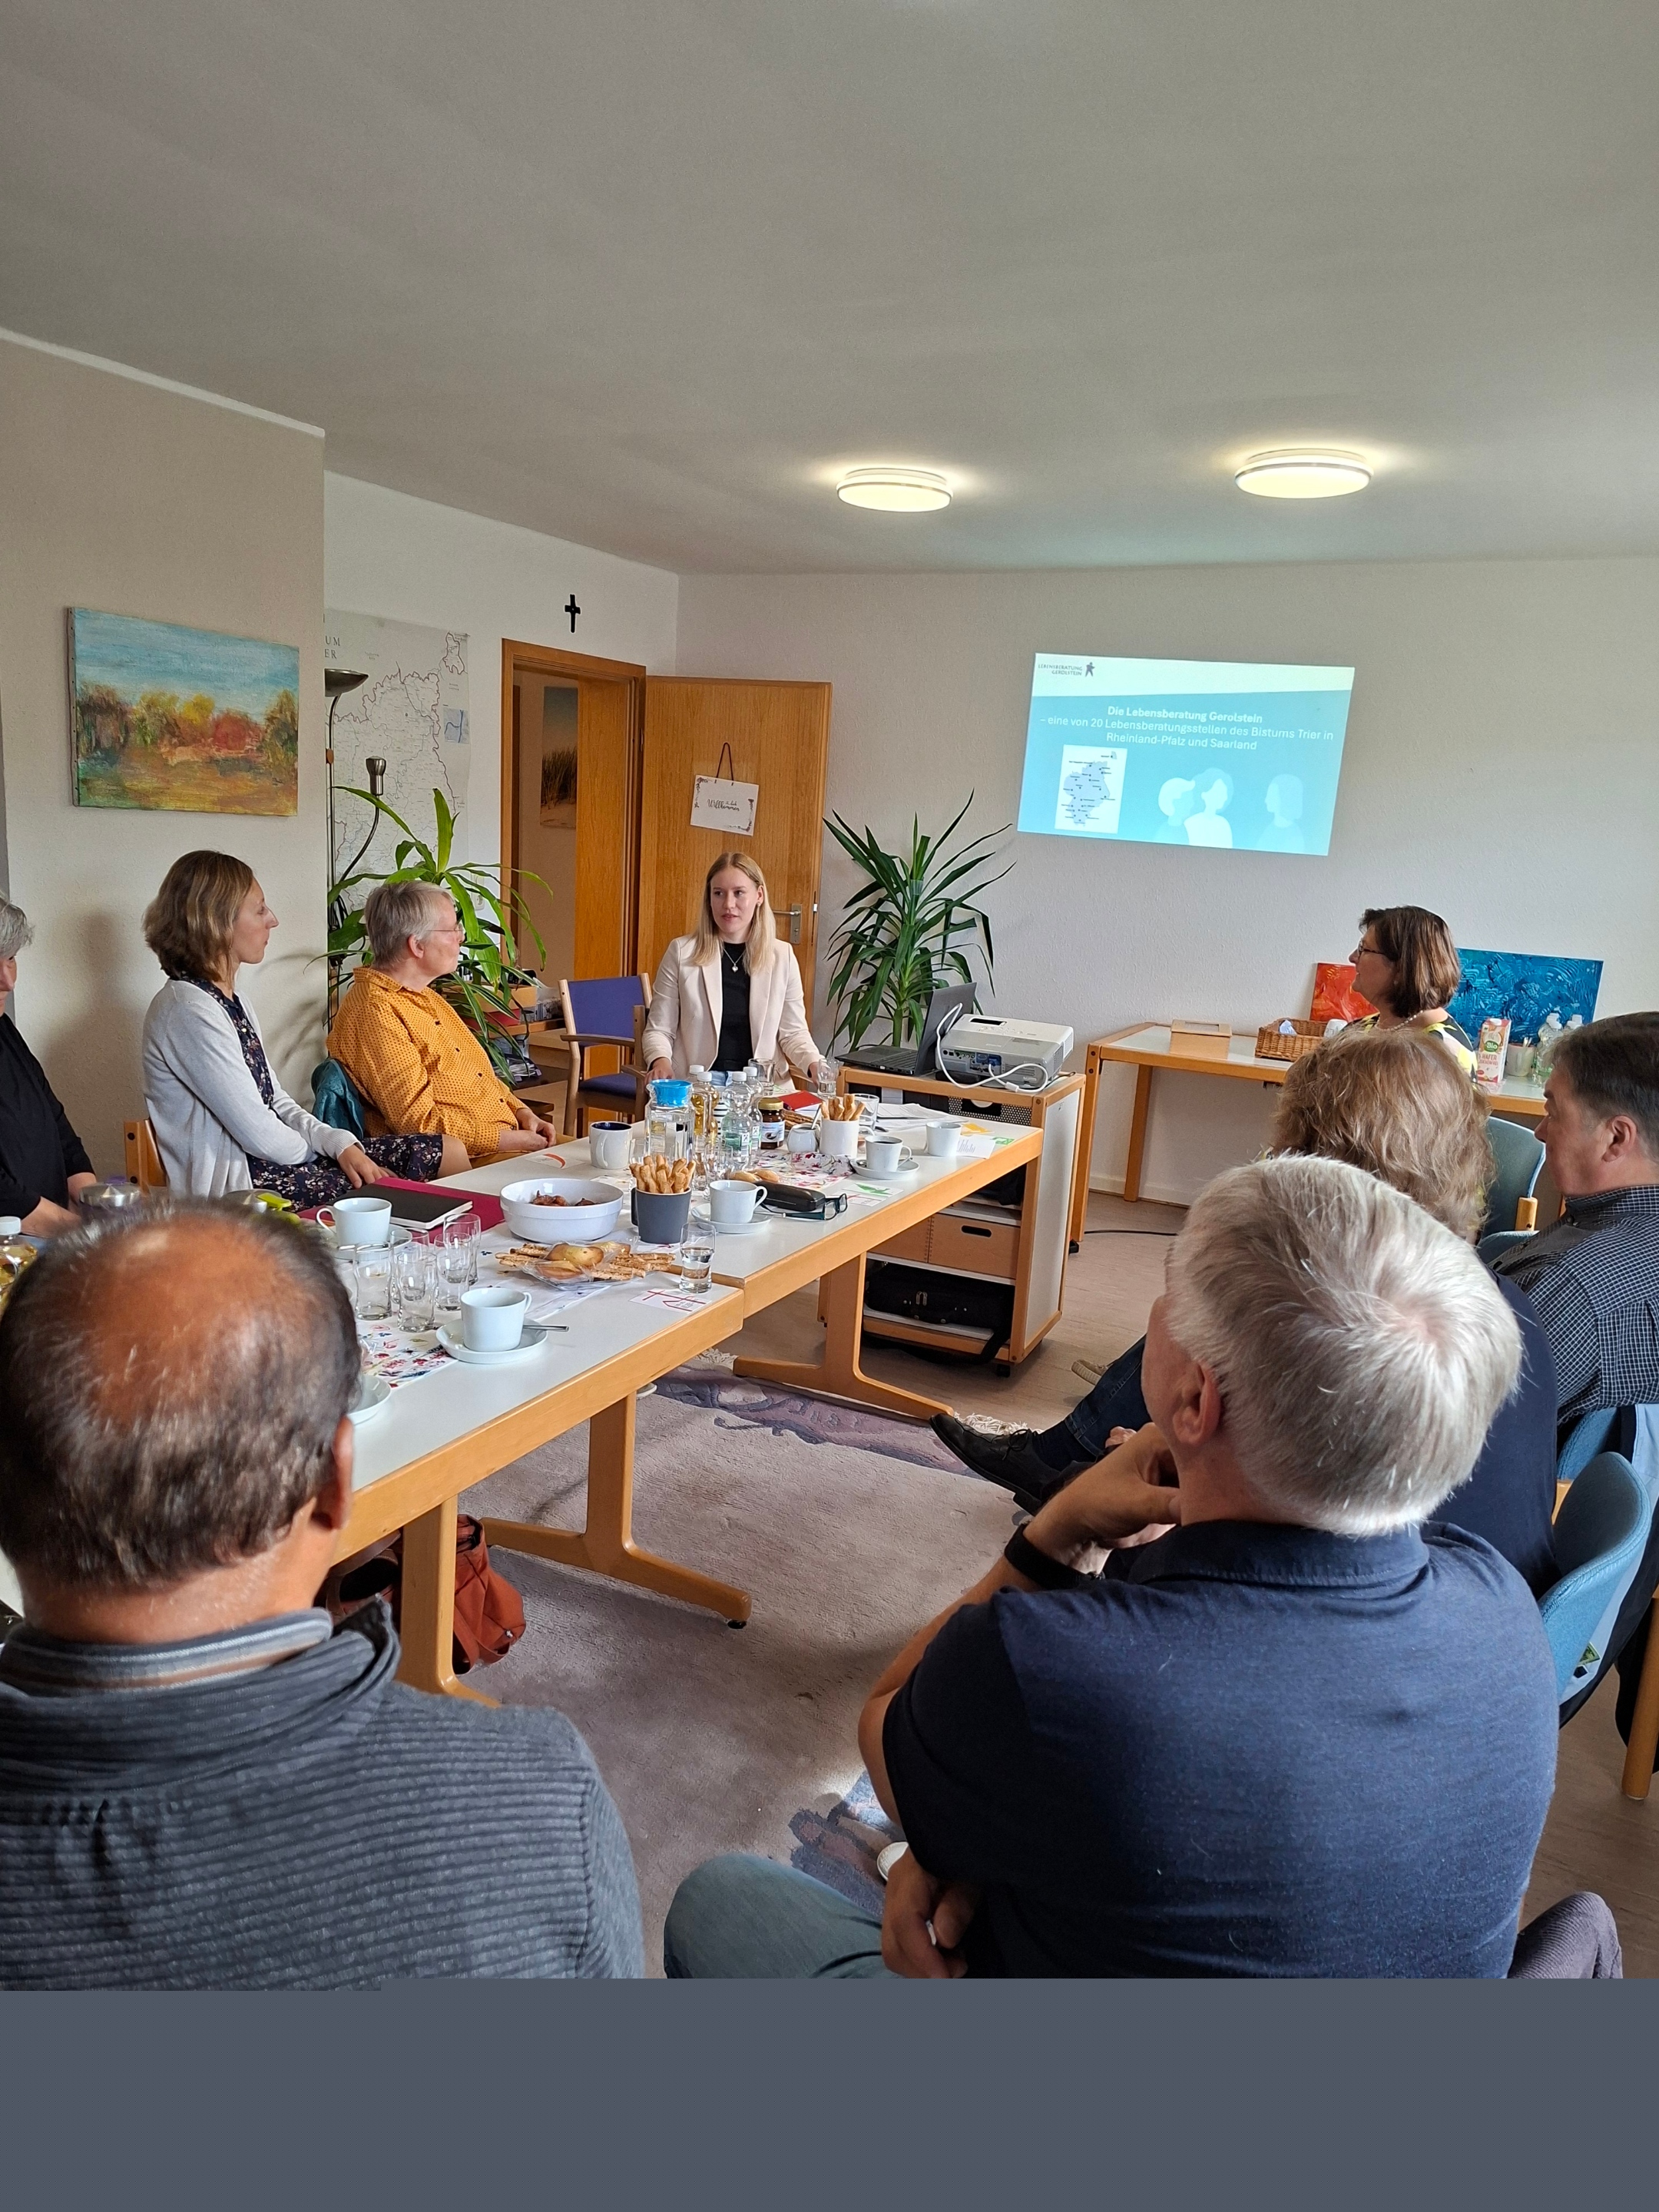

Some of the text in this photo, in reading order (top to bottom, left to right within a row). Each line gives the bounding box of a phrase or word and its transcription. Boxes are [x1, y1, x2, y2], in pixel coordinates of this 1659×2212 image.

[1108, 706, 1263, 724] Die Lebensberatung Gerolstein
[1048, 715, 1068, 725] eine
[1071, 718, 1088, 727] von
[1091, 718, 1103, 728] 20
[1105, 719, 1227, 735] Lebensberatungsstellen
[1230, 726, 1249, 737] des
[1251, 727, 1295, 739] Bistums
[1297, 729, 1321, 740] Trier
[1323, 730, 1334, 740] in
[1106, 732, 1257, 750] Rheinland-Pfalz und Saarland
